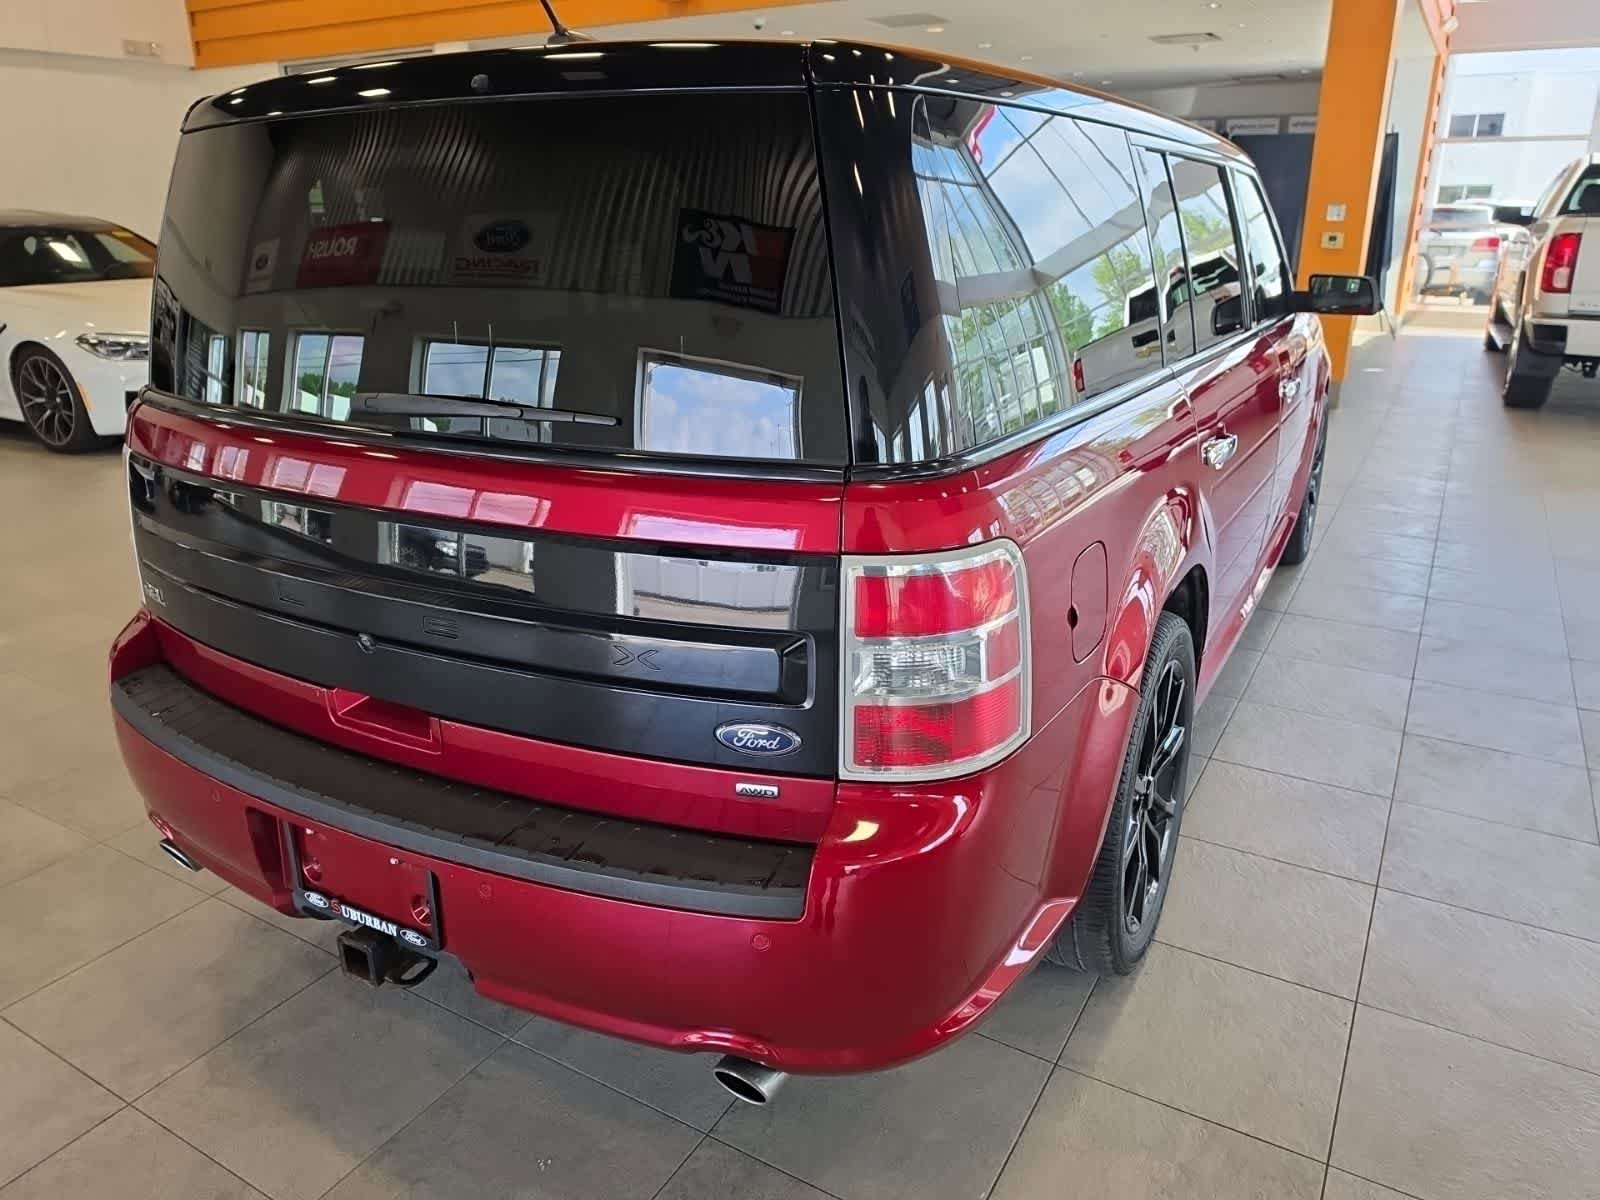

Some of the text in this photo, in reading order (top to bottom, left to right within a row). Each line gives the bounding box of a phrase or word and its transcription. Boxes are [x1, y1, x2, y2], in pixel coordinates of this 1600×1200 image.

[733, 728, 781, 750] Ford
[739, 787, 776, 797] AWD
[330, 899, 398, 937] SUBURBAN
